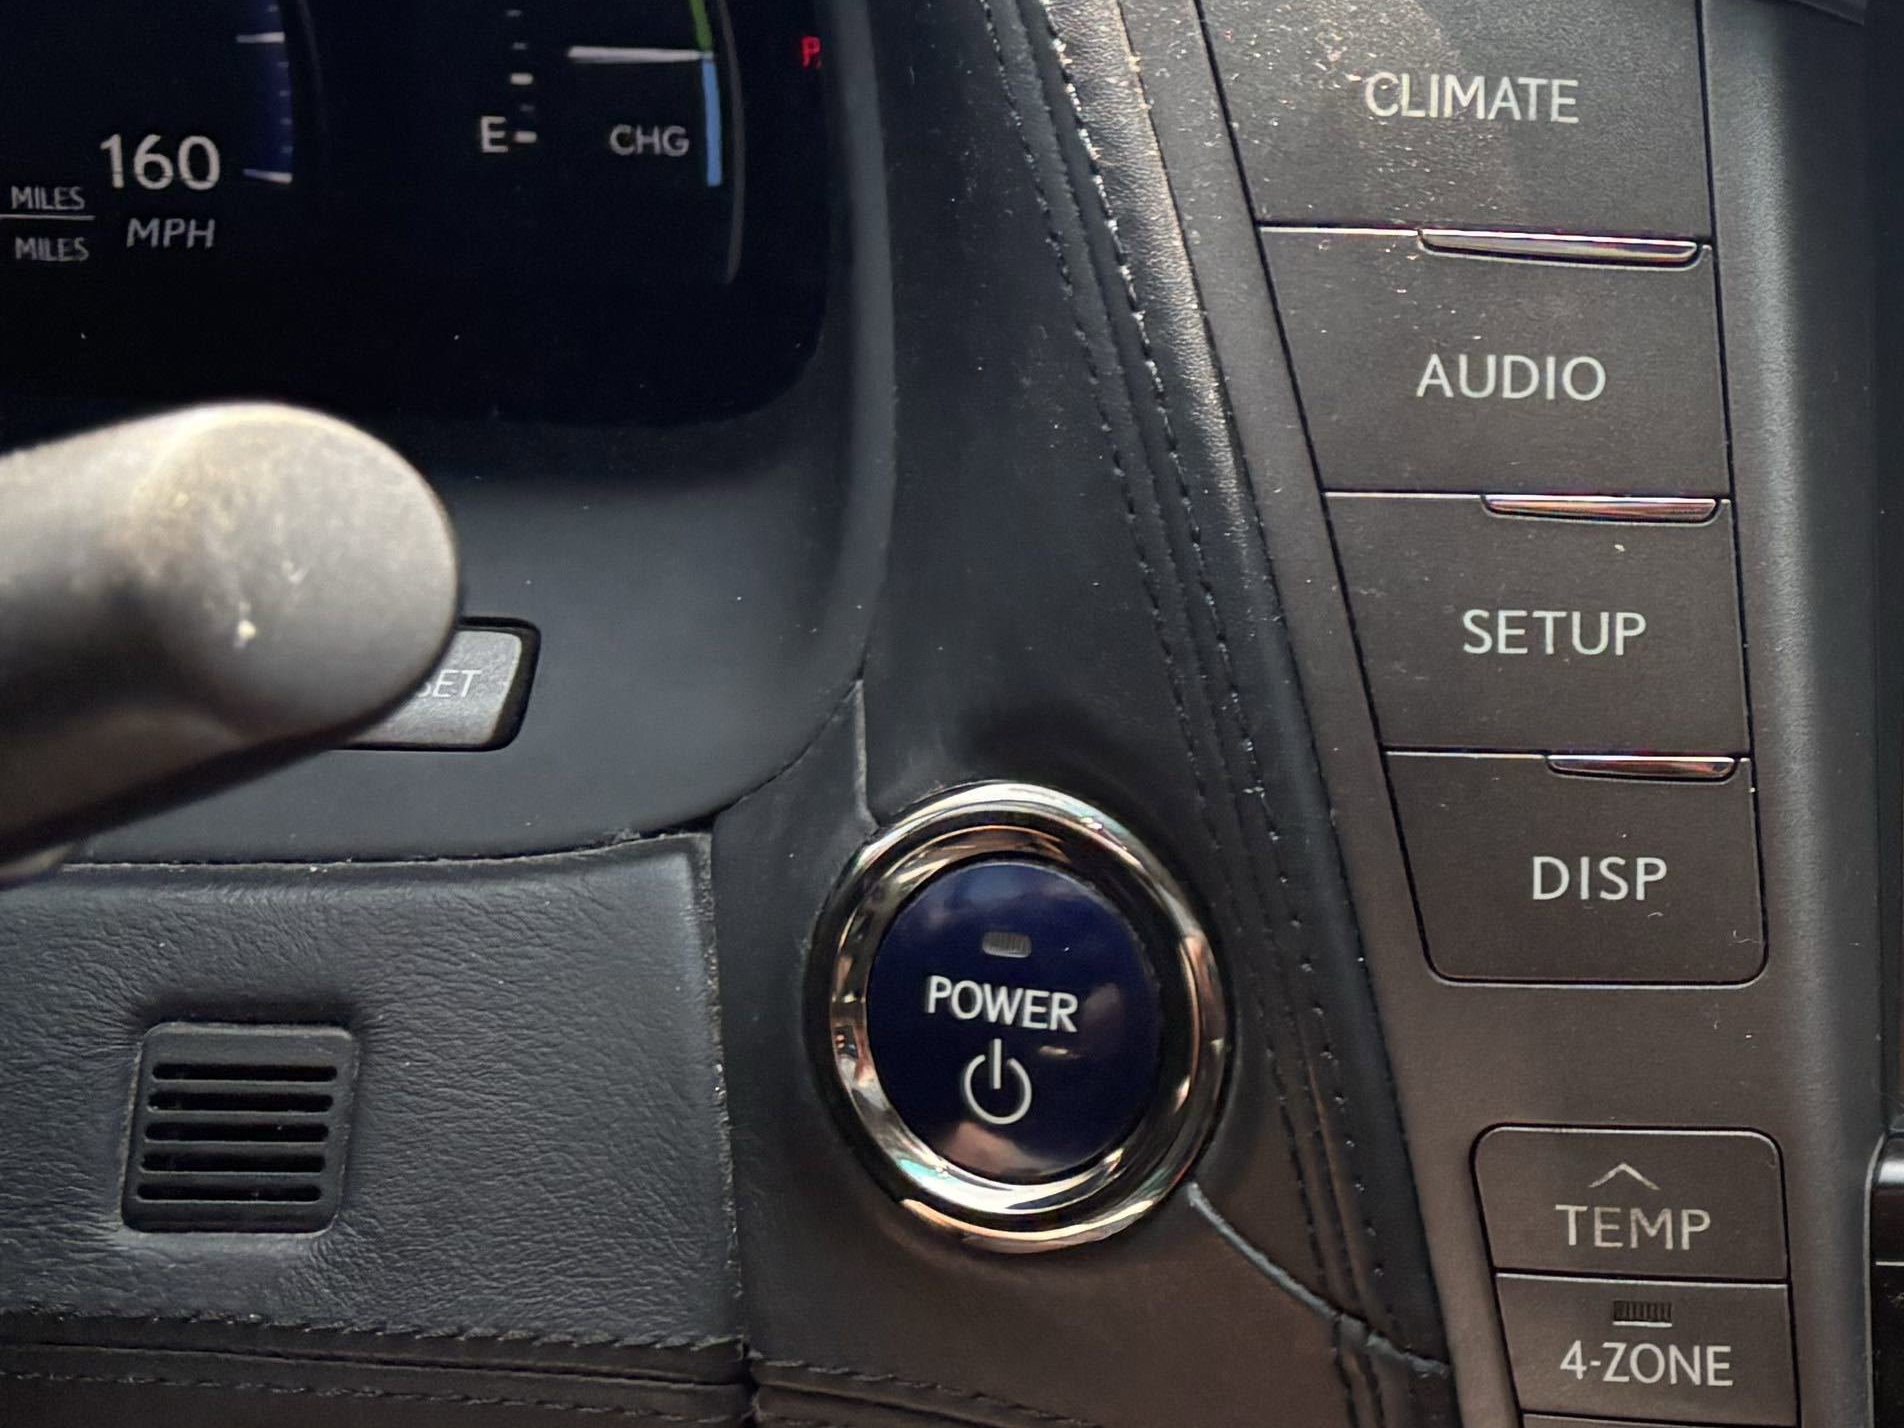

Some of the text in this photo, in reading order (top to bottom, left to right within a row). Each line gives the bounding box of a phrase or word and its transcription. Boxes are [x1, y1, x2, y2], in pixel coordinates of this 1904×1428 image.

[1366, 72, 1579, 124] CLIMATE
[480, 115, 509, 153] E
[609, 123, 689, 157] CHG
[99, 134, 221, 190] 160
[11, 185, 86, 211] MILES
[15, 236, 90, 262] MILES
[125, 217, 216, 249] MPH
[1416, 353, 1606, 402] AUDIO
[1462, 609, 1647, 656] SETUP
[1531, 855, 1668, 902] DISP
[925, 974, 1079, 1033] POWER
[1555, 1204, 1712, 1251] TEMP
[1559, 1339, 1734, 1387] 4-ZONE
